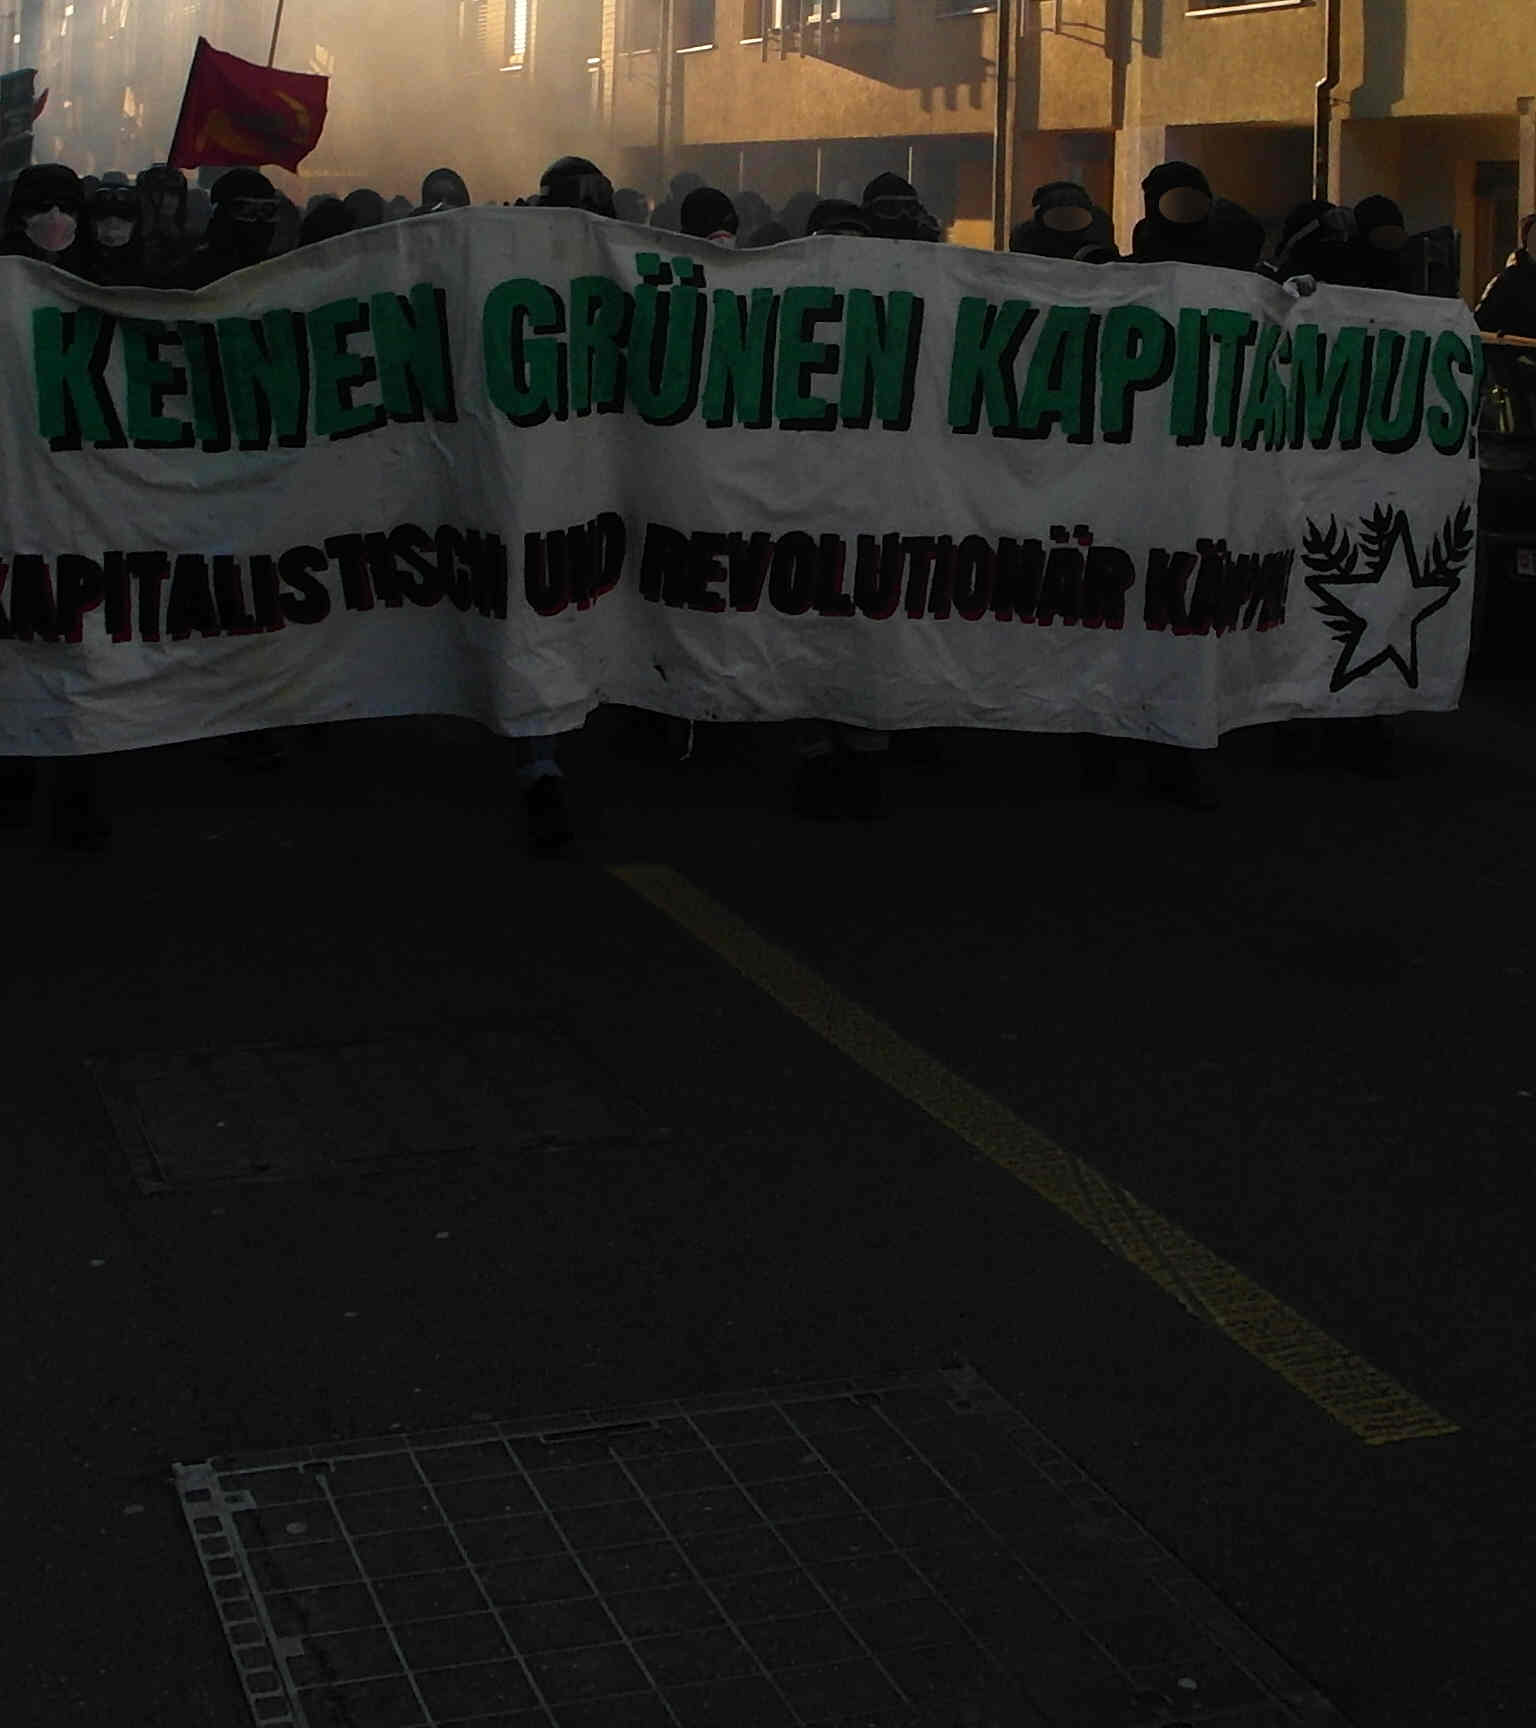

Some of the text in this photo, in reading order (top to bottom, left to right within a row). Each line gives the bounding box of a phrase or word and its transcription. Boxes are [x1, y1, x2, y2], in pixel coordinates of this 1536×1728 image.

[32, 283, 458, 454] KEINEN
[482, 252, 925, 432] GRÜNEN
[640, 522, 1136, 630] REVOLUTIONÄR
